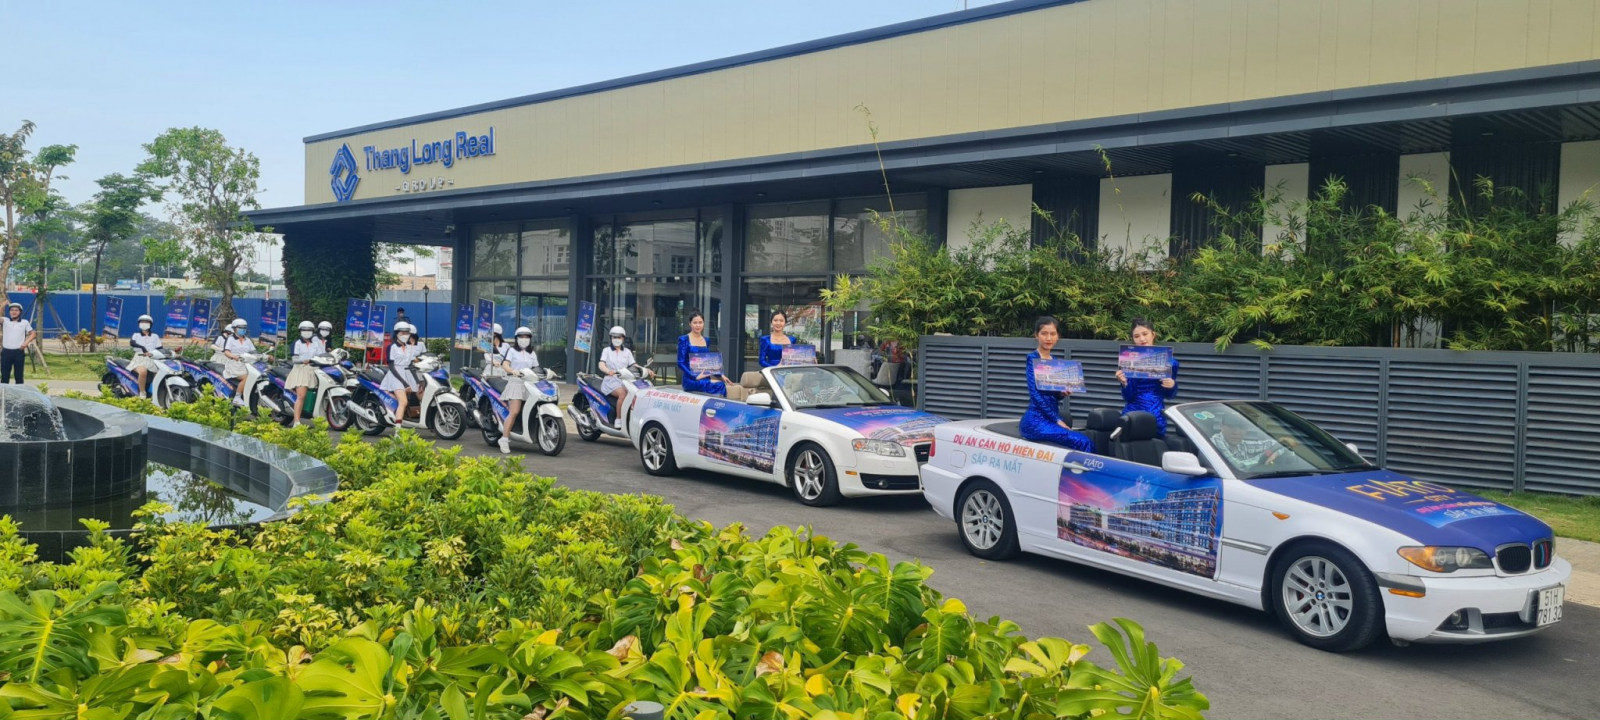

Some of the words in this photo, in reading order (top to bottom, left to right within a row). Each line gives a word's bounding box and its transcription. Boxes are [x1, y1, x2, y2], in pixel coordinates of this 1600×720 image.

[363, 145, 411, 174] Thang
[412, 138, 454, 168] Long
[455, 126, 496, 159] Real
[988, 456, 1001, 469] RA
[1544, 588, 1559, 607] 51H
